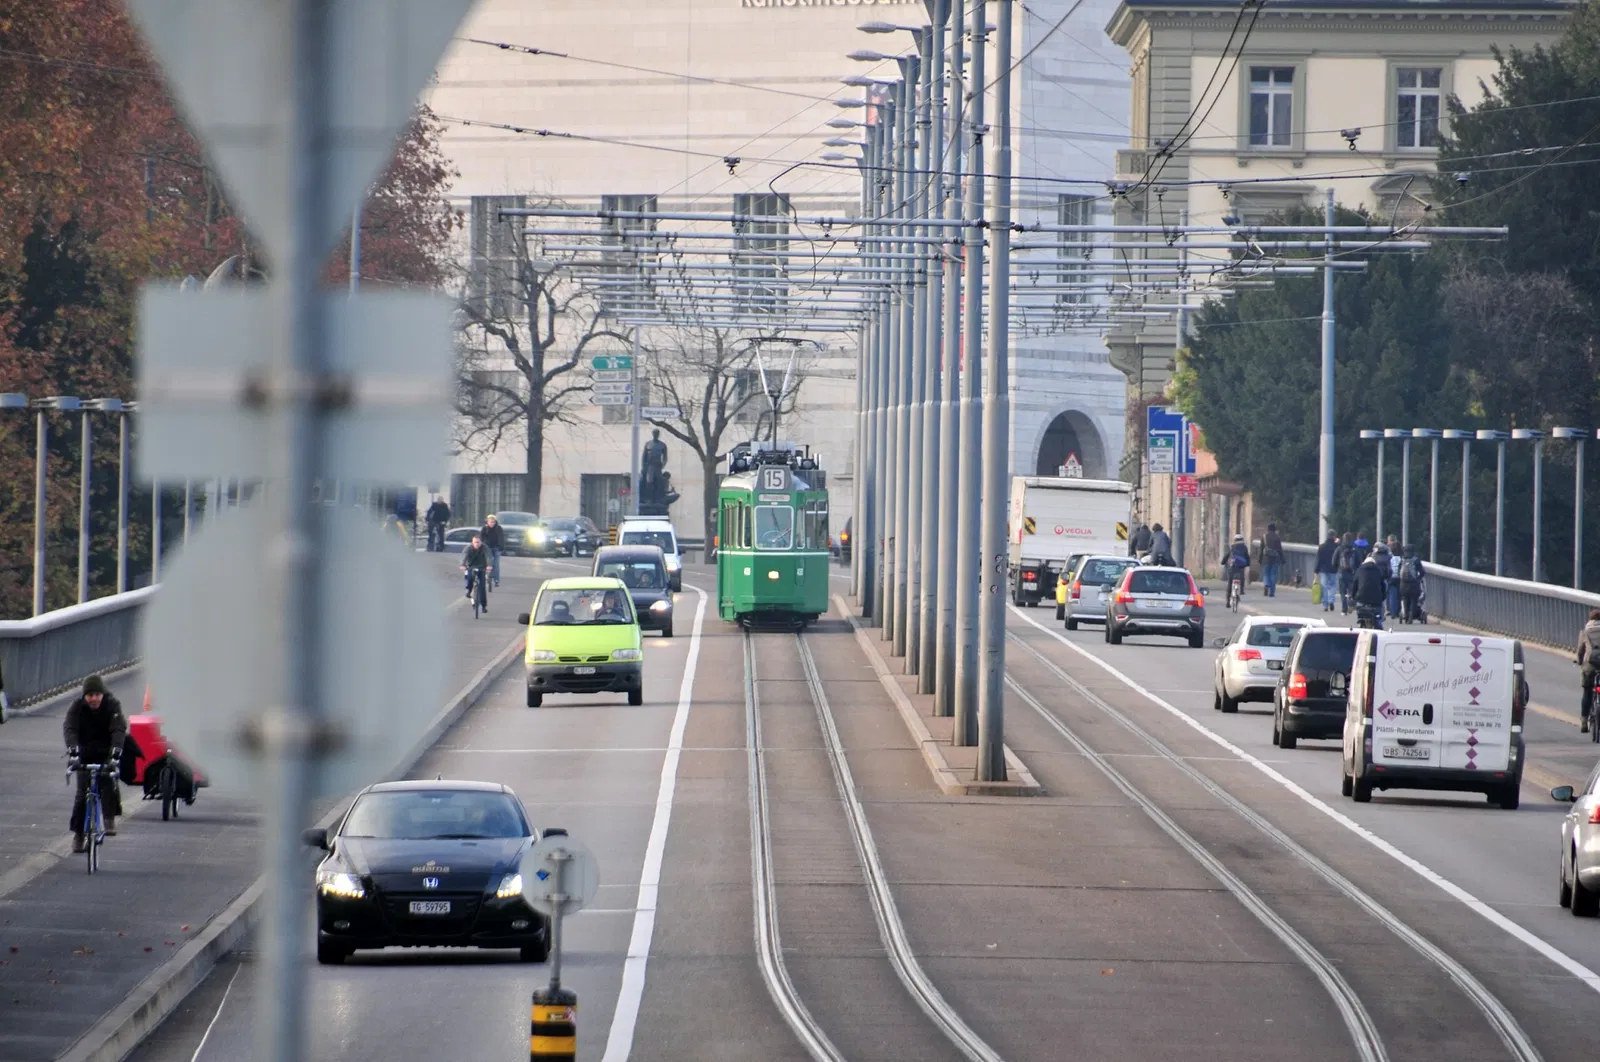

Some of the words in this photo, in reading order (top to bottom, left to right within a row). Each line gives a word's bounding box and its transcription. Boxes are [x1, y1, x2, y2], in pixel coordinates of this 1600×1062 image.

[766, 470, 782, 487] 15
[1065, 527, 1092, 535] VEOLIA
[1396, 680, 1431, 697] schnell
[1432, 679, 1450, 690] und
[1452, 669, 1493, 690] günstig!
[1387, 708, 1420, 717] KERA
[1390, 747, 1399, 756] BS
[1401, 748, 1423, 757] 74256
[411, 902, 421, 911] TG
[425, 902, 448, 912] 59795
